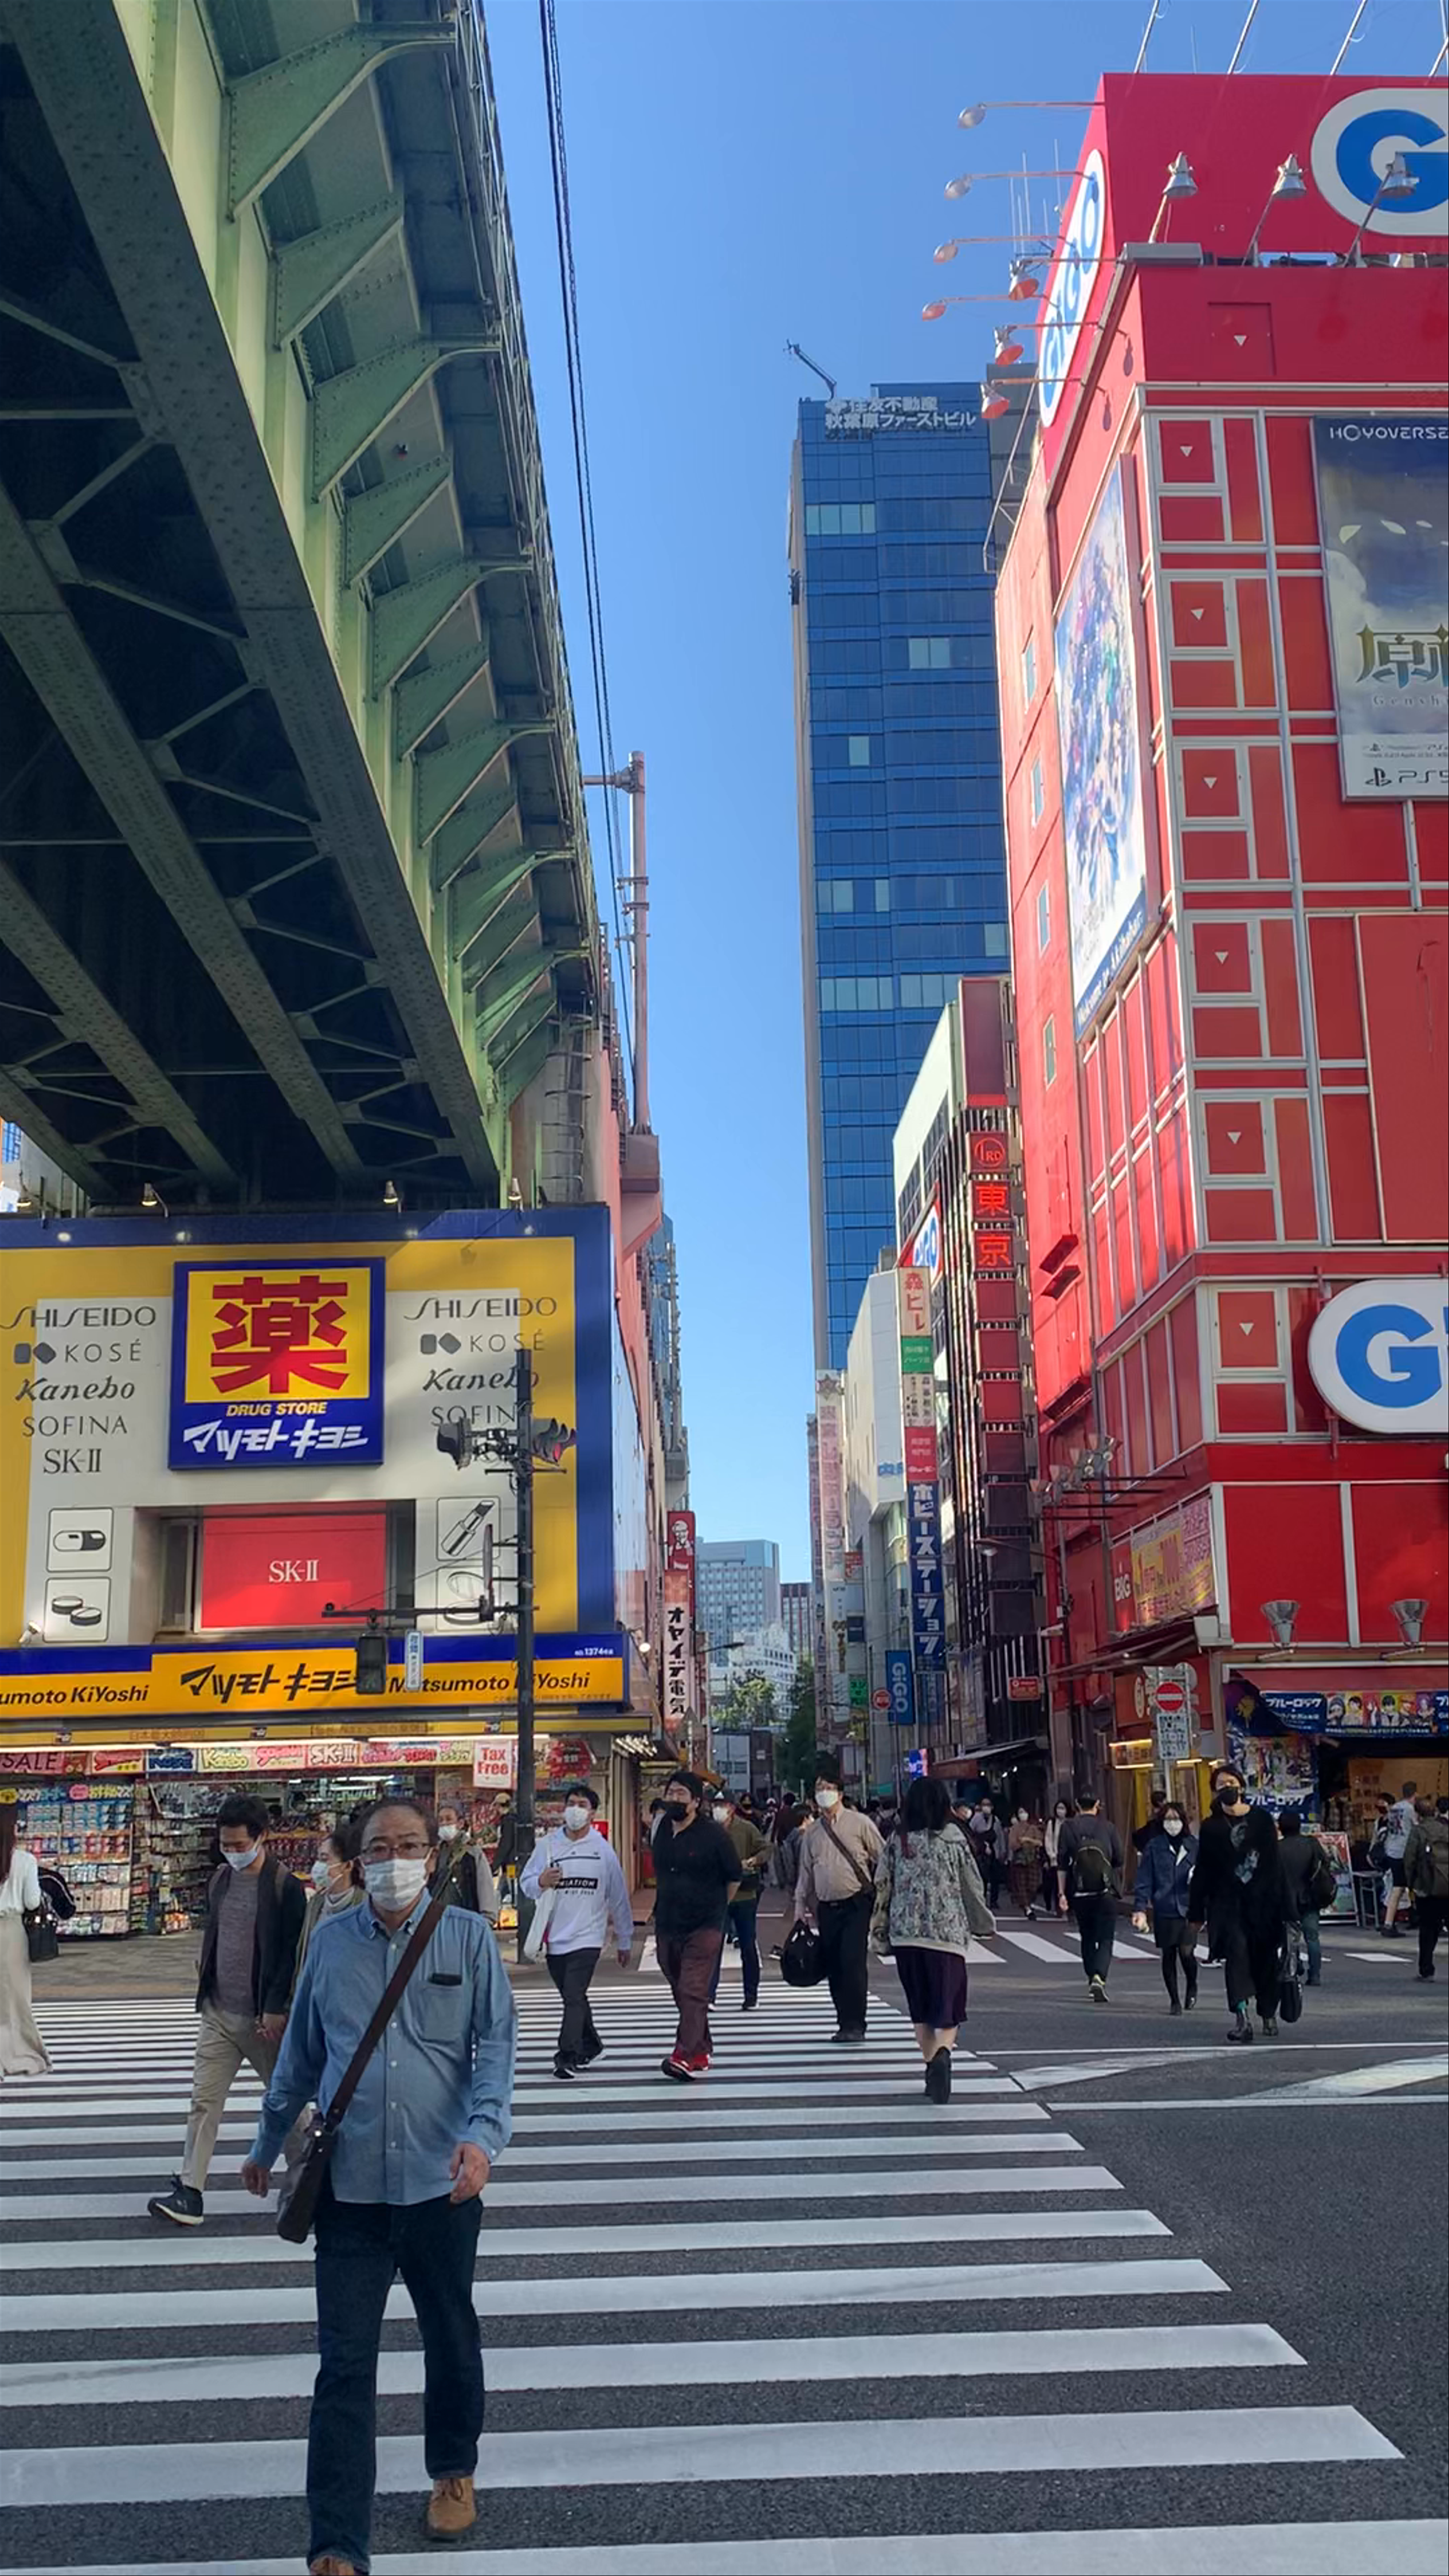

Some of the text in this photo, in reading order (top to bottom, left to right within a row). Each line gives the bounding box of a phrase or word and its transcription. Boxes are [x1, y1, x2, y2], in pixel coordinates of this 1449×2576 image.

[825, 411, 977, 429] 秋葉原ファーストビル
[1329, 424, 1449, 441] HOYOVERSE
[1373, 695, 1449, 705] Gensh
[976, 1183, 1011, 1267] 東京
[0, 1306, 156, 1329] SHISEIDO
[404, 1297, 557, 1320] SHISEIDO
[210, 1275, 350, 1394] 薬
[470, 1329, 545, 1352] KOSÉ
[65, 1339, 141, 1362] KOSÉ
[15, 1376, 135, 1401] Kanebo
[226, 1402, 327, 1416] DRUG STORE
[431, 1405, 518, 1426] SOFIN
[23, 1415, 128, 1437] SOFINA
[183, 1419, 368, 1460] マツモトキヨシ
[43, 1448, 102, 1474] SK-II
[269, 1559, 318, 1583] SK-II
[668, 1607, 685, 1715] オヤイデ電気
[71, 1684, 149, 1703] KiYoshi
[181, 1663, 357, 1704] マツモトキヨシ
[388, 1672, 590, 1693] Mtsumoto iYoshi
[892, 1662, 909, 1713] GiGO
[1266, 1697, 1322, 1708] ブルーロック
[2, 1752, 57, 1770] SALE
[310, 1743, 356, 1765] SK-II
[481, 1748, 506, 1761] Tax
[477, 1762, 509, 1775] Free
[1245, 1795, 1305, 1806] ブルーロック
